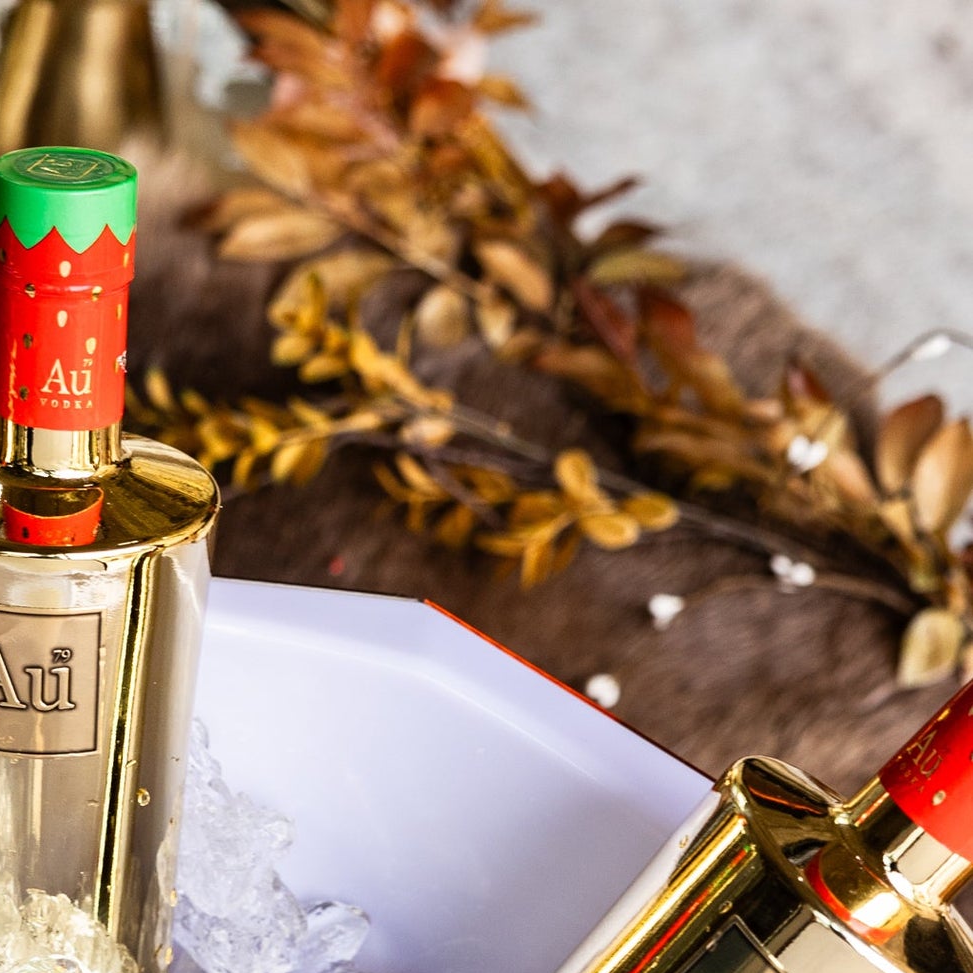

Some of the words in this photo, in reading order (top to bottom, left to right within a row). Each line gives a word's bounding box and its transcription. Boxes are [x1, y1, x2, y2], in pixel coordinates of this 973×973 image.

[40, 359, 92, 396] Au
[40, 398, 93, 409] VODKA
[51, 648, 73, 663] 79
